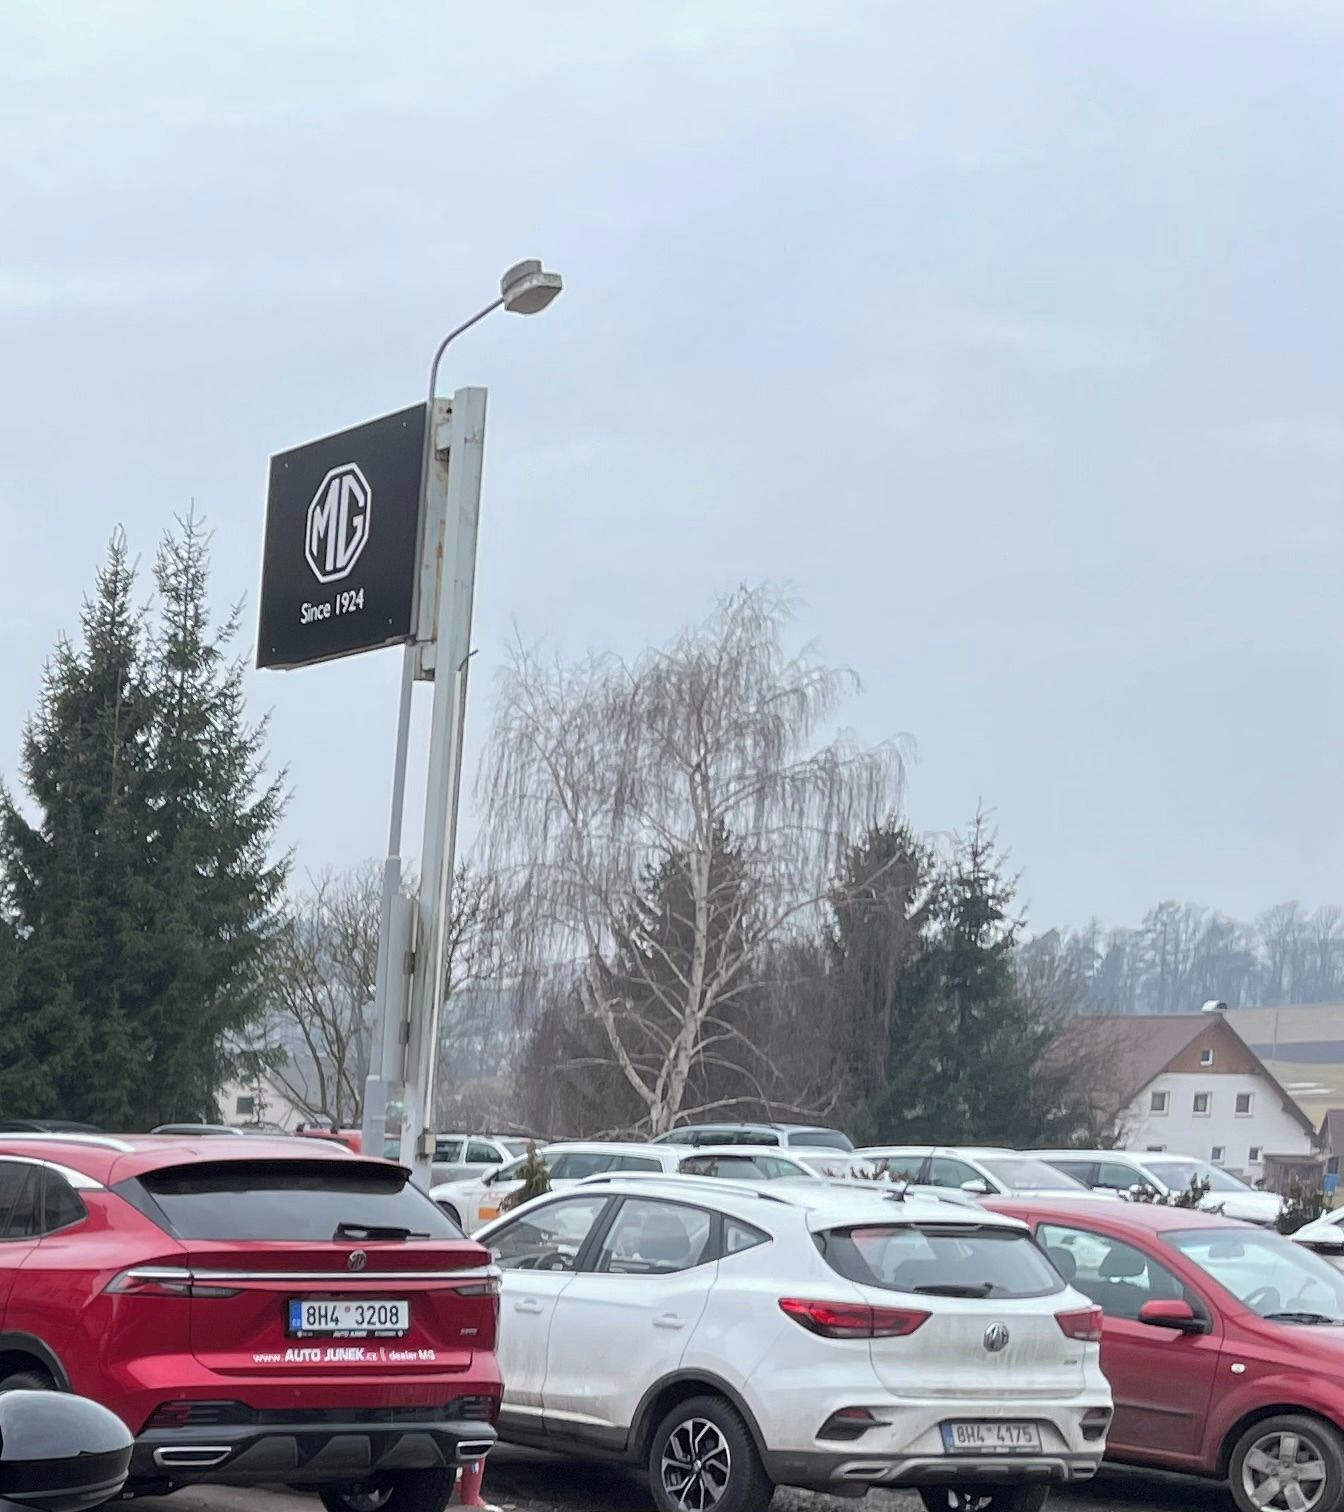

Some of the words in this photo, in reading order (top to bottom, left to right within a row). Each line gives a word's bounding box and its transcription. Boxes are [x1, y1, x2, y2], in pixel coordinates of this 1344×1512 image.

[311, 473, 366, 572] MG
[299, 600, 331, 625] Since
[335, 587, 365, 615] 1924
[306, 1304, 340, 1326] 8H4
[354, 1304, 400, 1326] 3208
